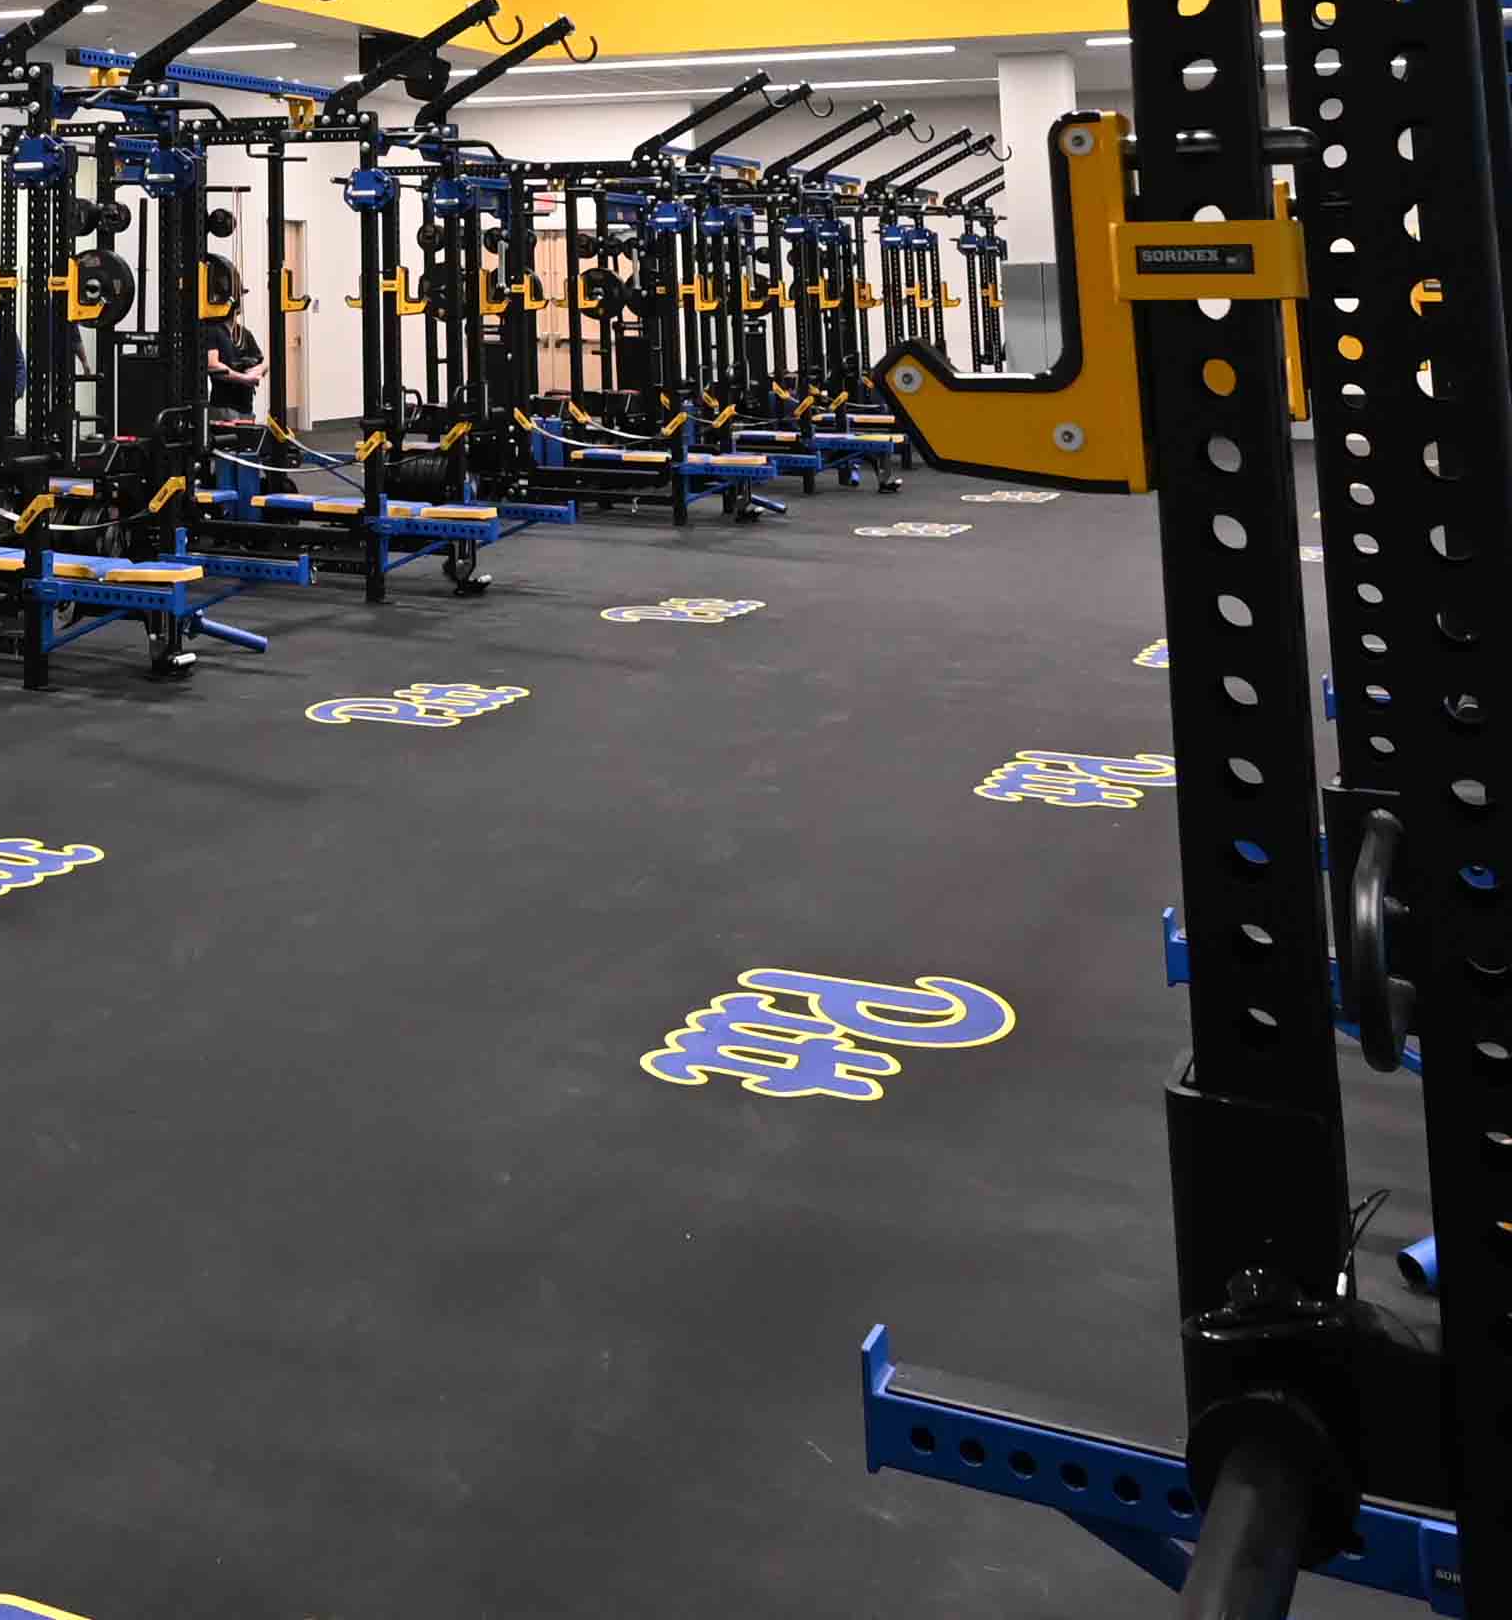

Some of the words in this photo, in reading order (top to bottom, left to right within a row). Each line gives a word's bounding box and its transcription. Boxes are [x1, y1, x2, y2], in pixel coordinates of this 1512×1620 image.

[1142, 249, 1219, 263] SORINEX
[305, 681, 531, 728] Pitt
[639, 966, 1016, 1102] Pitt
